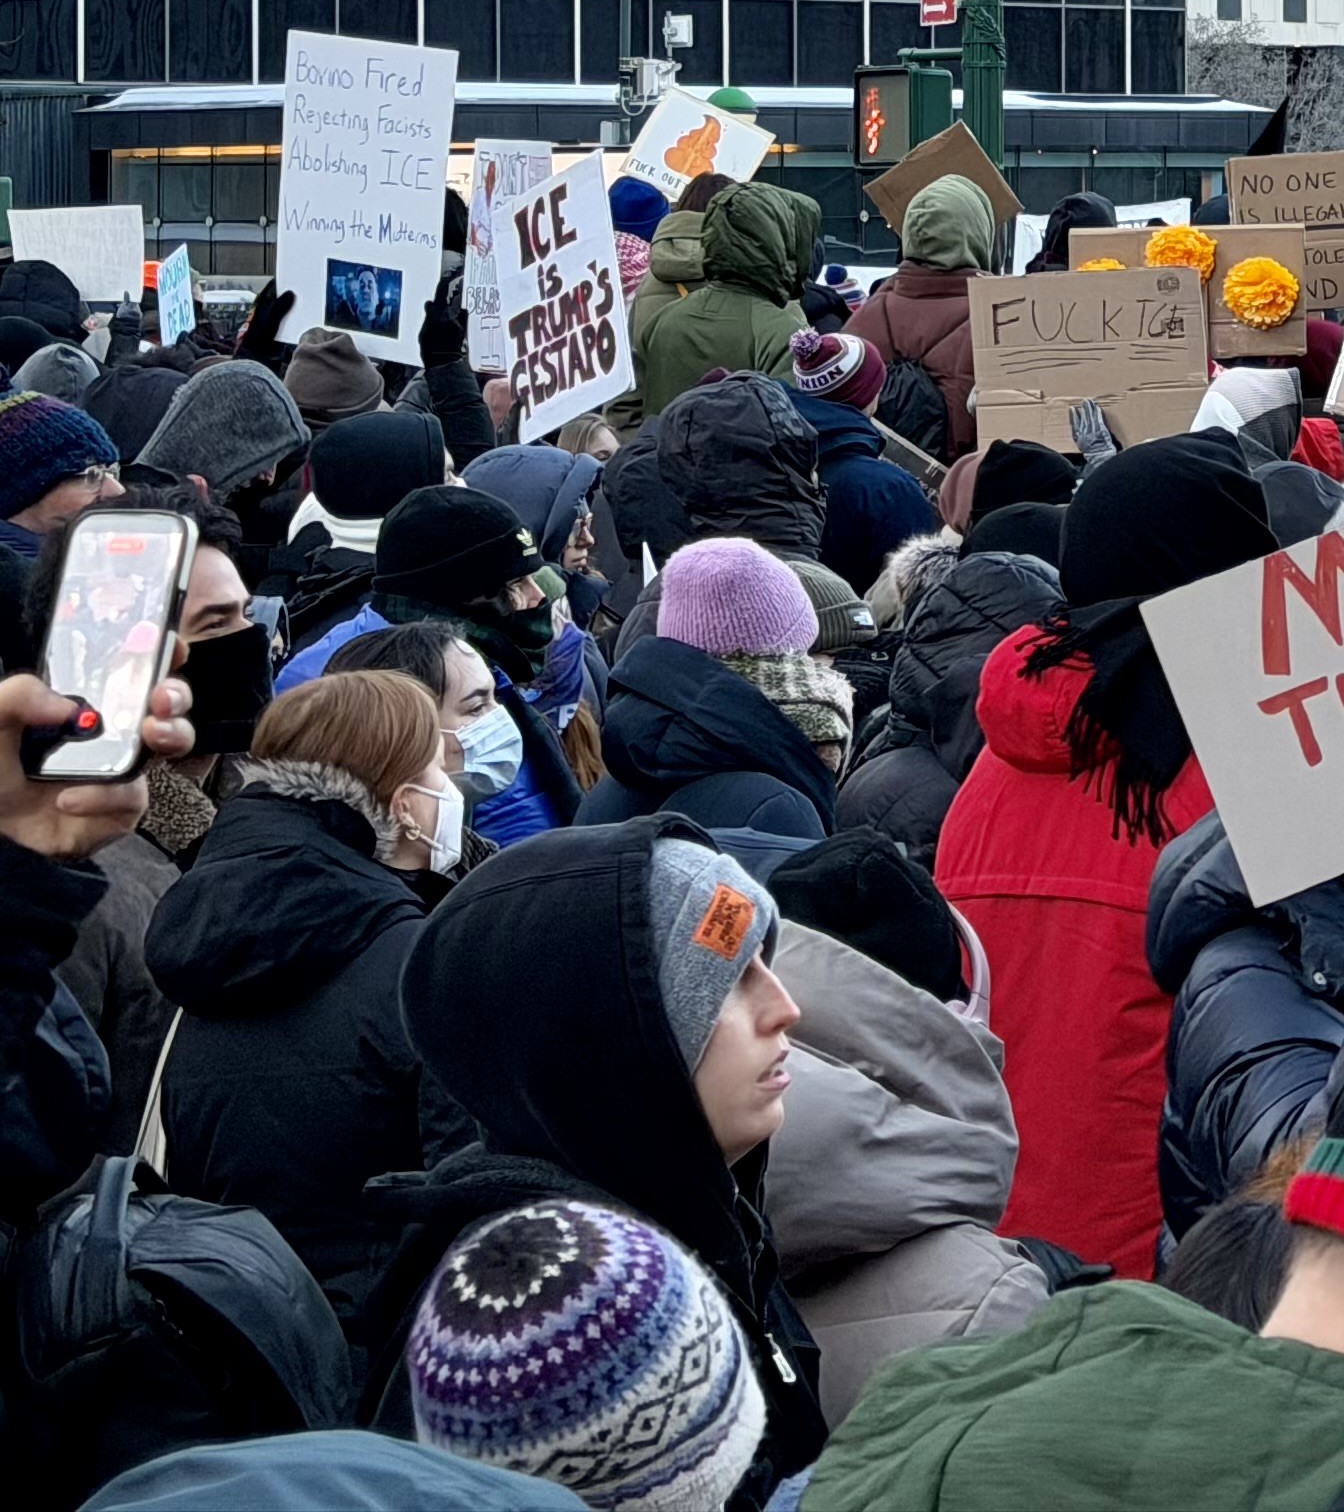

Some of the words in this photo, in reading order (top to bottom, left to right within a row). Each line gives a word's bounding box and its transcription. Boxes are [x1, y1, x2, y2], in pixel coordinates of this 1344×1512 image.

[365, 57, 424, 97] Fired
[293, 93, 369, 145] Rejecting
[377, 104, 432, 139] Facists
[288, 136, 368, 194] Abolishing
[380, 149, 434, 190] ICE
[628, 158, 657, 177] FUCK
[661, 170, 682, 189] OUT
[1240, 174, 1274, 195] NO
[1286, 171, 1338, 191] ONE
[285, 196, 345, 243] Winning
[350, 208, 372, 239] the
[514, 181, 577, 270] ICE
[1239, 206, 1260, 225] IS
[167, 298, 191, 339] DEAD
[509, 259, 614, 359] TRUMP'S
[992, 297, 1123, 345] FUCK
[1136, 299, 1186, 339] ICE
[510, 316, 617, 422] GESTAPO
[798, 365, 845, 389] NION
